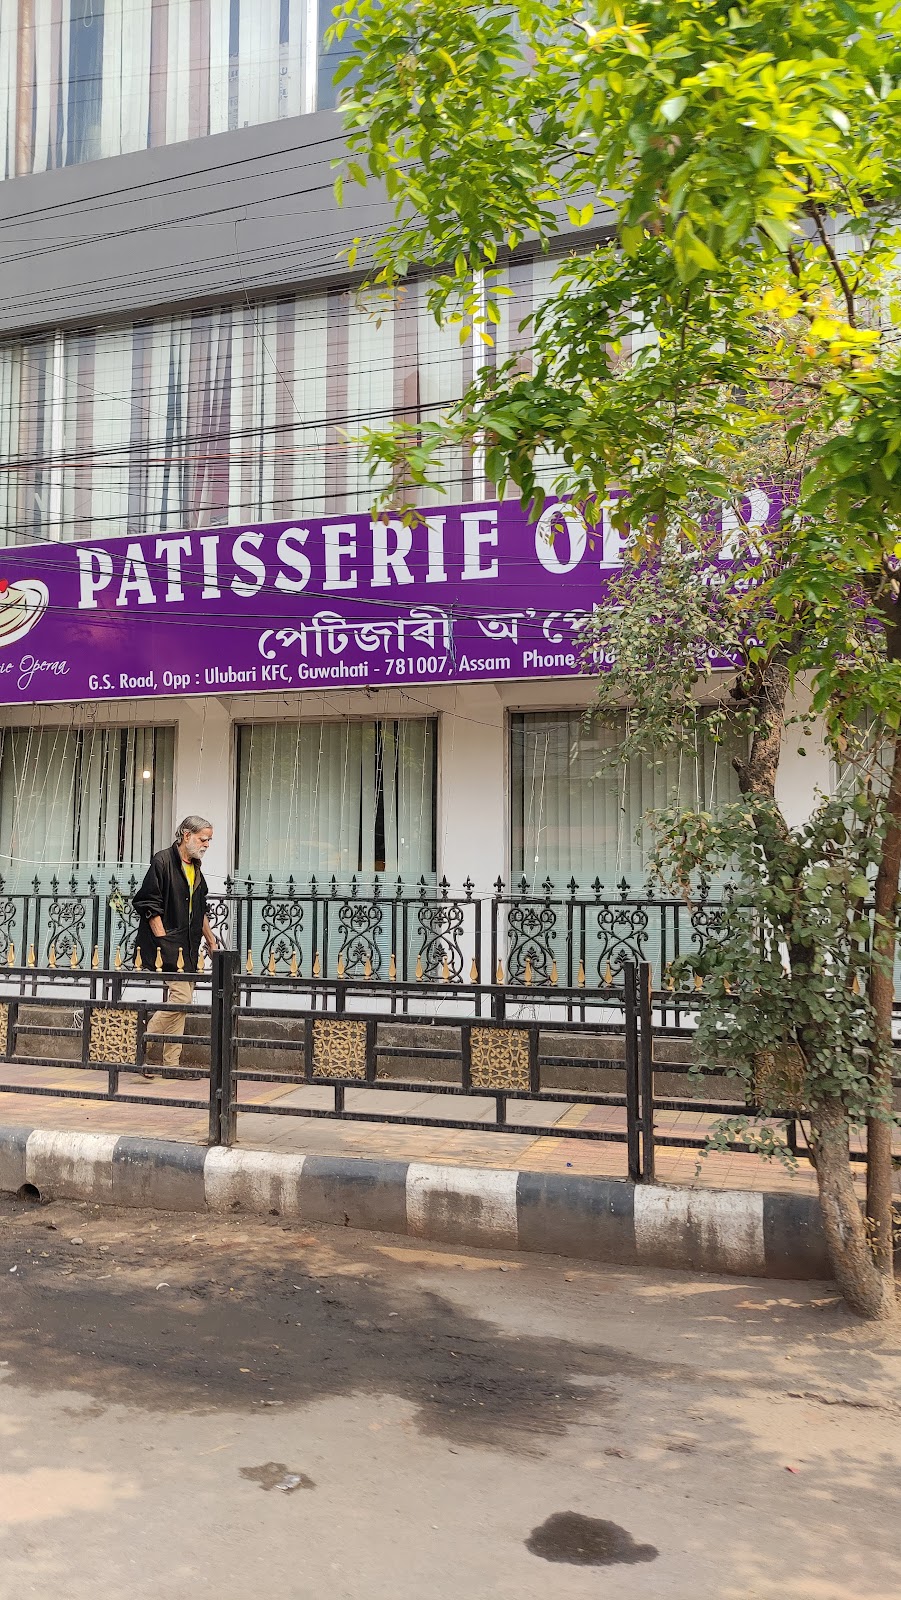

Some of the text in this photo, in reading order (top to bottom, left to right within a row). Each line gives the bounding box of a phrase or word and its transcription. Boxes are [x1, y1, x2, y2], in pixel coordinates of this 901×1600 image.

[77, 508, 499, 608] PATISSERIE
[88, 674, 115, 690] G.S.
[119, 671, 158, 690] Road,
[162, 670, 191, 689] Opp
[205, 665, 256, 684] Ulubari
[261, 664, 293, 683] KFC,
[298, 660, 368, 680] Guwahati
[385, 656, 453, 676] 781007,
[459, 655, 511, 672] Assam
